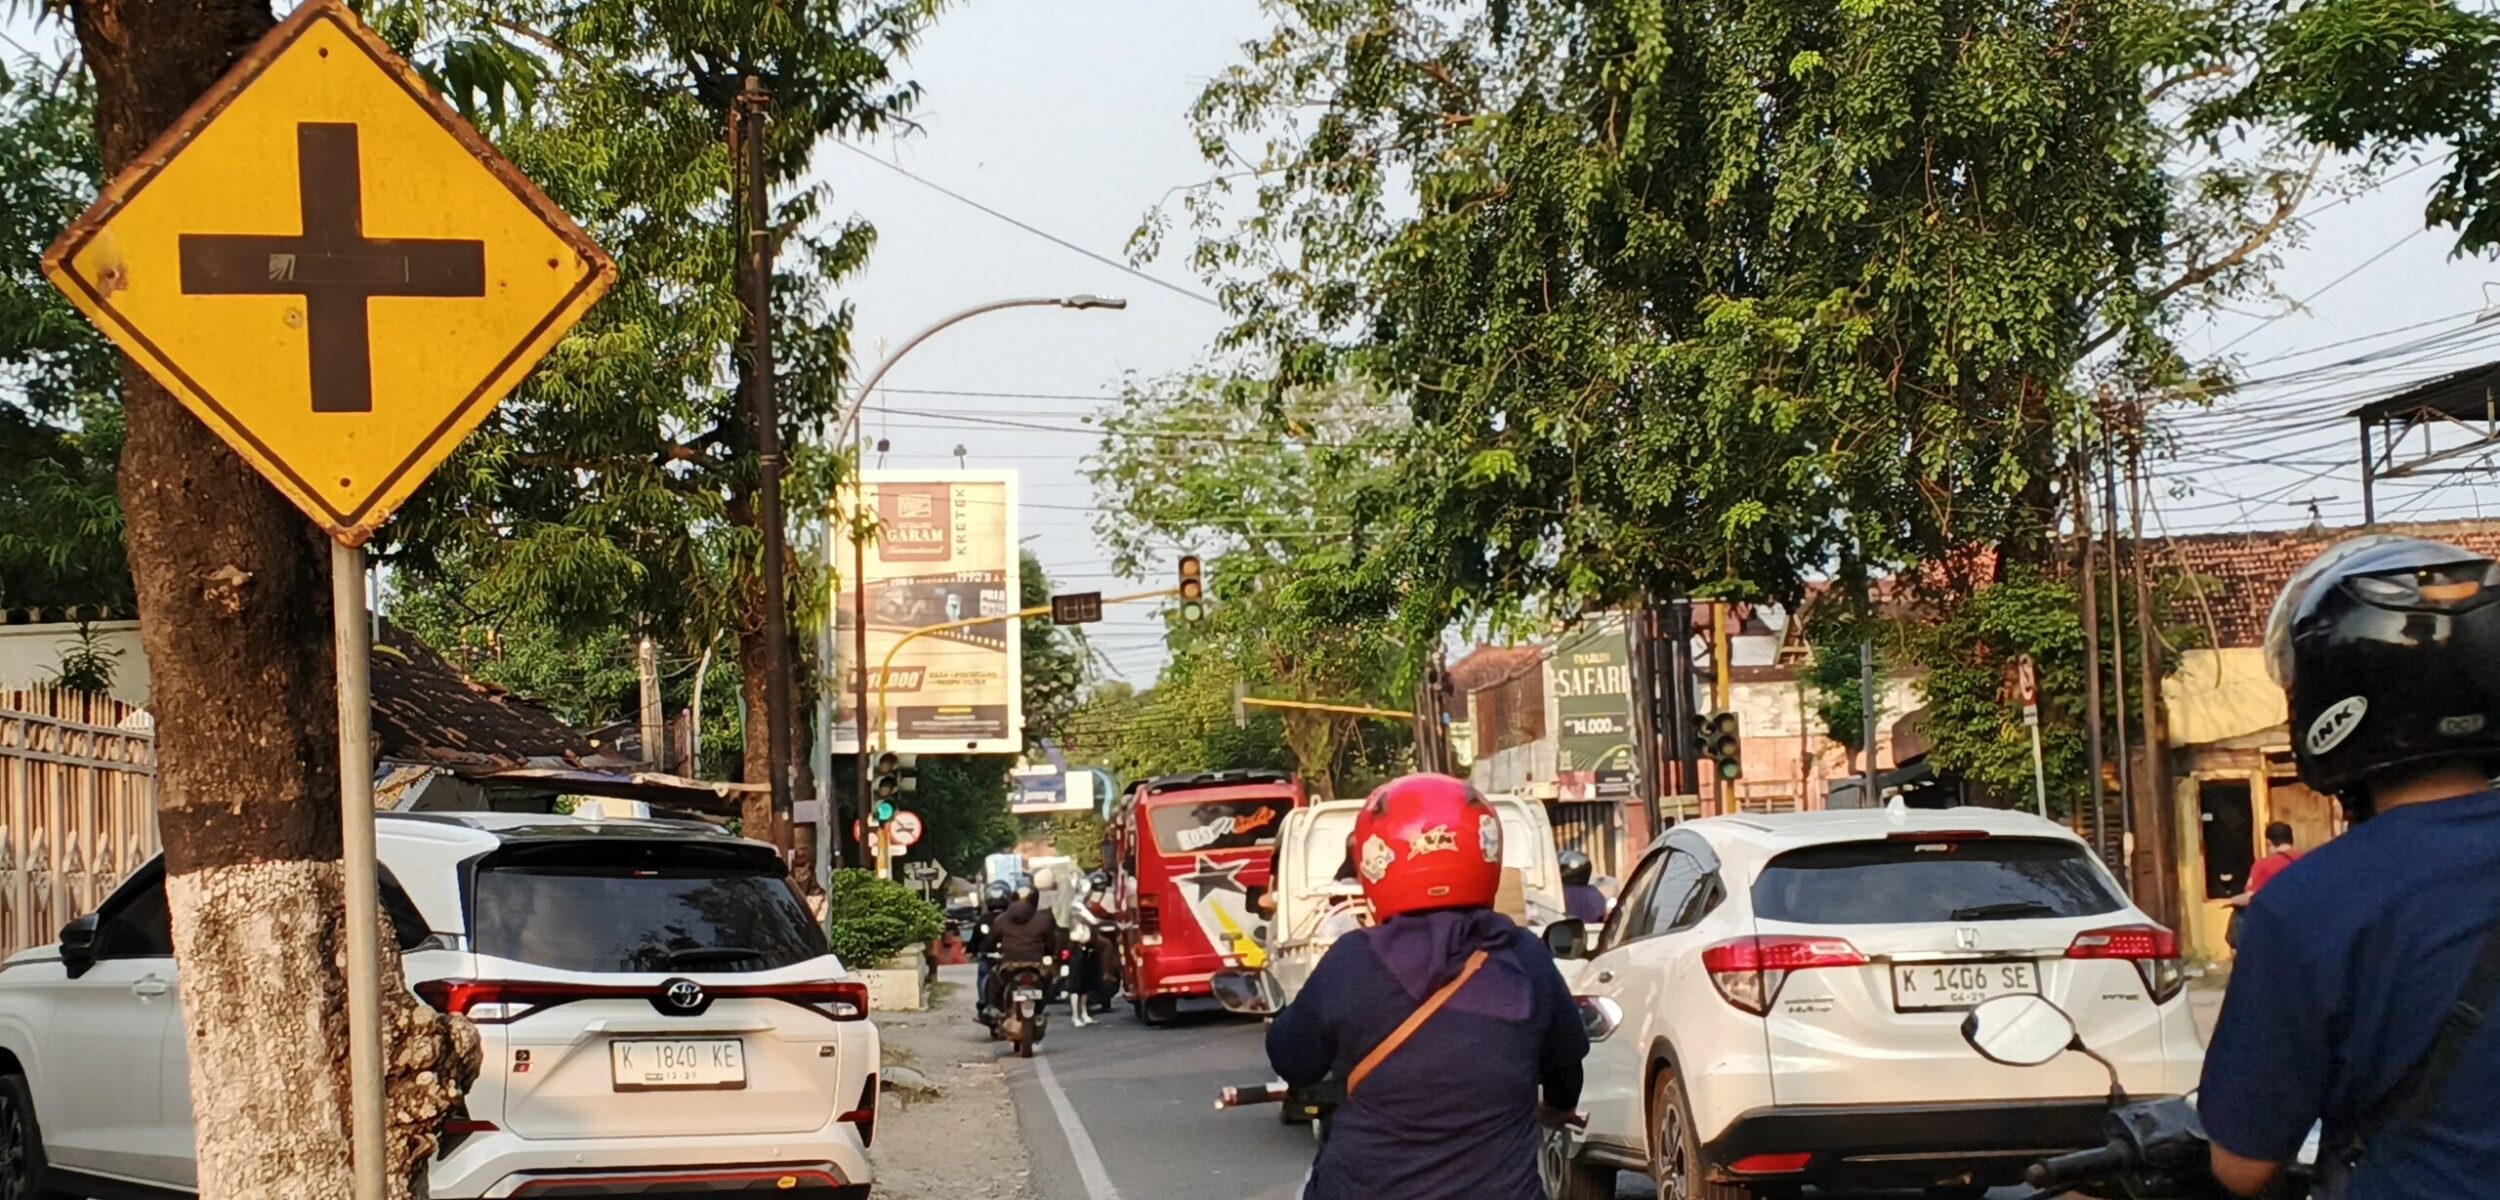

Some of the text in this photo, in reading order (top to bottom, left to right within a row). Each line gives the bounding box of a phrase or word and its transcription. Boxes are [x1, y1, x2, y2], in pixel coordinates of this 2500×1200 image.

[886, 529, 944, 543] GARAM
[955, 489, 966, 555] KRETEK
[1558, 665, 1628, 697] SAFARI
[2311, 704, 2355, 748] INK
[1902, 966, 2029, 992] K 1406 SE
[622, 1044, 735, 1069] K 1840 KE
